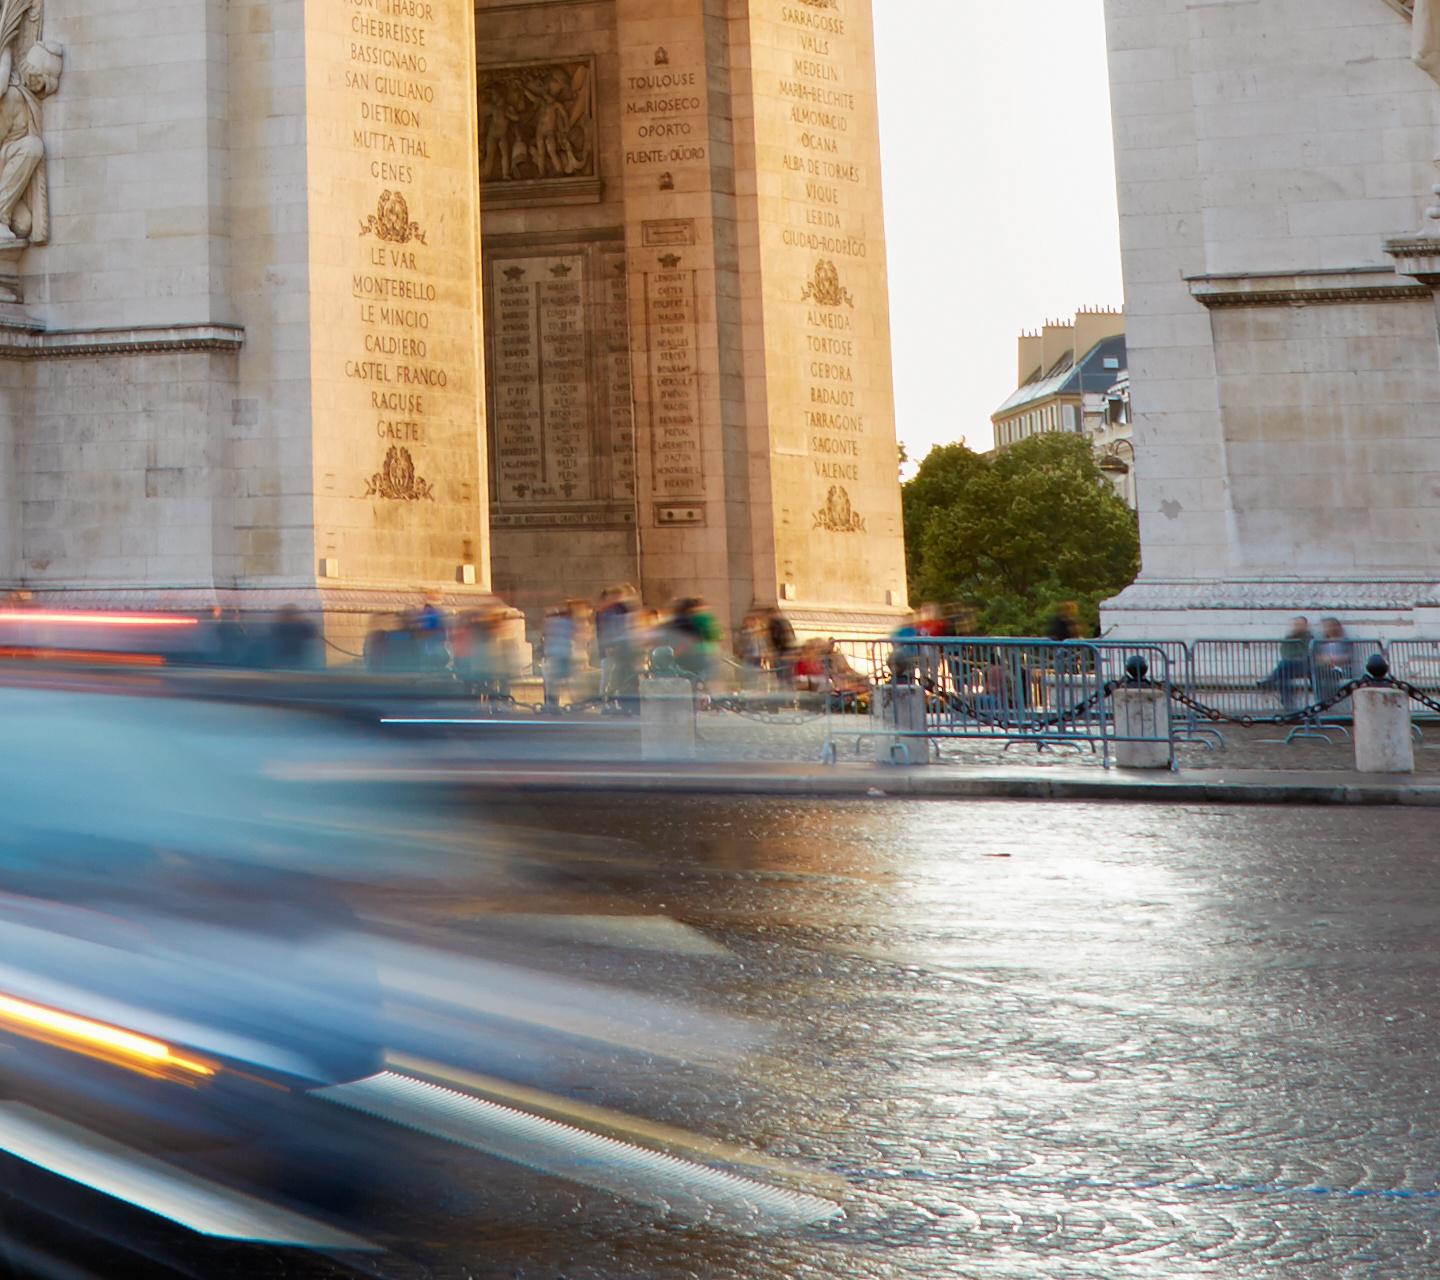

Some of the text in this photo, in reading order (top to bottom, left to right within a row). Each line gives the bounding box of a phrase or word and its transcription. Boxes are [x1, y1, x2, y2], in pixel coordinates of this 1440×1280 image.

[352, 16, 425, 46] CHEBREISSE
[782, 7, 845, 35] SARRAGOSSE
[800, 35, 829, 55] VALLS
[351, 43, 427, 73] BASSIGNANO
[628, 73, 695, 89] TOULOUSE
[795, 59, 838, 81] MEDELIN
[345, 71, 434, 103] SAN GIULIANO
[361, 102, 420, 128] DIETIKON
[791, 107, 847, 132] ALMONACID
[638, 122, 691, 138] OPORTO
[353, 129, 431, 159] MUTTA THAL
[371, 161, 413, 184] GENES
[784, 154, 860, 183] ALBA DE TORMES
[806, 183, 839, 204] VIQUE
[807, 208, 841, 229] LERIDA
[783, 230, 866, 258] CIUDAD-RODRIGO
[372, 247, 417, 270] LE VAR
[353, 275, 436, 301] MONTEBELLO
[361, 304, 429, 329] LE MINCIO
[808, 311, 852, 330] ALMEIDA
[365, 334, 427, 358] CALDIERO
[807, 335, 853, 356] TORTOSE
[345, 360, 447, 387] CASTEL FRANCO
[811, 362, 853, 382] GEBORA
[371, 391, 423, 413] RAGUSE
[811, 387, 855, 407] BADAJOZ
[377, 421, 419, 440] GAETE
[804, 411, 864, 433] TARRAGONE
[812, 437, 858, 456] SAGONTE
[814, 461, 858, 481] VALENCE
